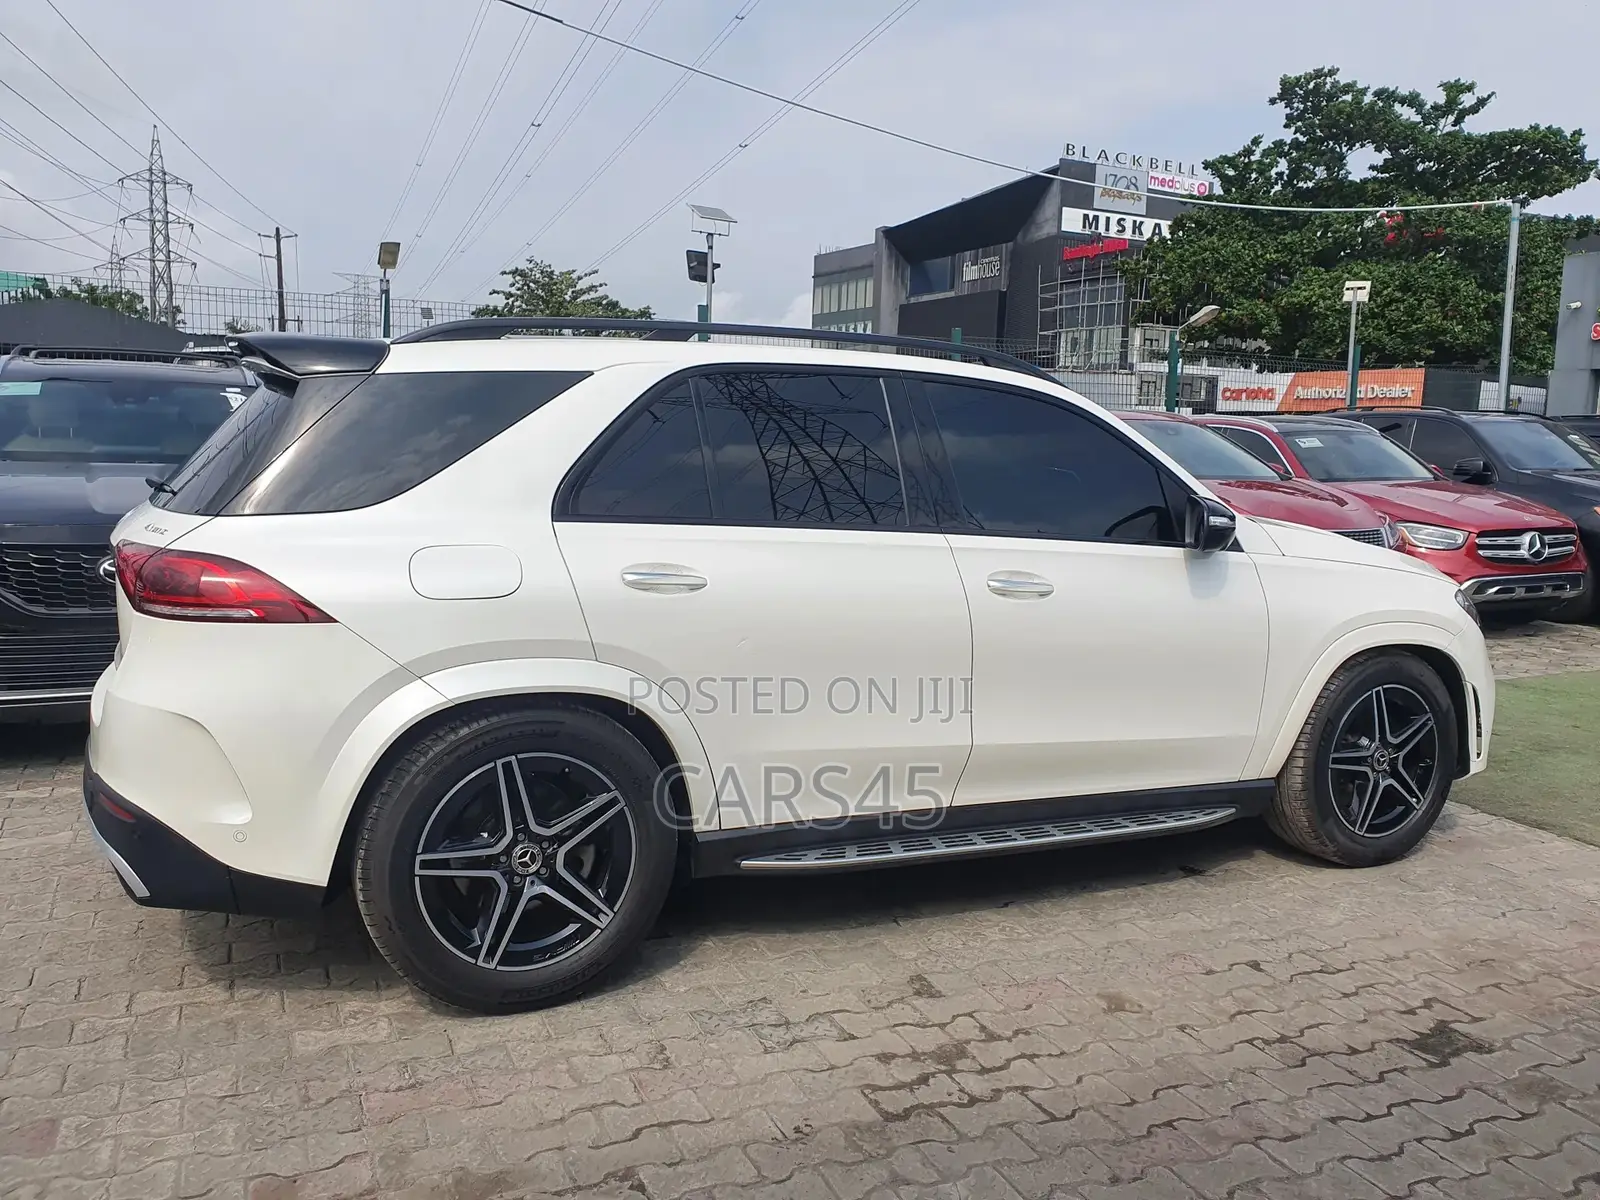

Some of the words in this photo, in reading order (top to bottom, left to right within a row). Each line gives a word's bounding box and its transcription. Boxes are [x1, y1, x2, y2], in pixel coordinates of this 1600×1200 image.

[1065, 143, 1198, 176] BLACKBELL
[1149, 174, 1196, 193] medplus
[962, 259, 1001, 282] filmhouse
[1293, 384, 1364, 400] Authorizd
[1367, 384, 1415, 399] Dealer
